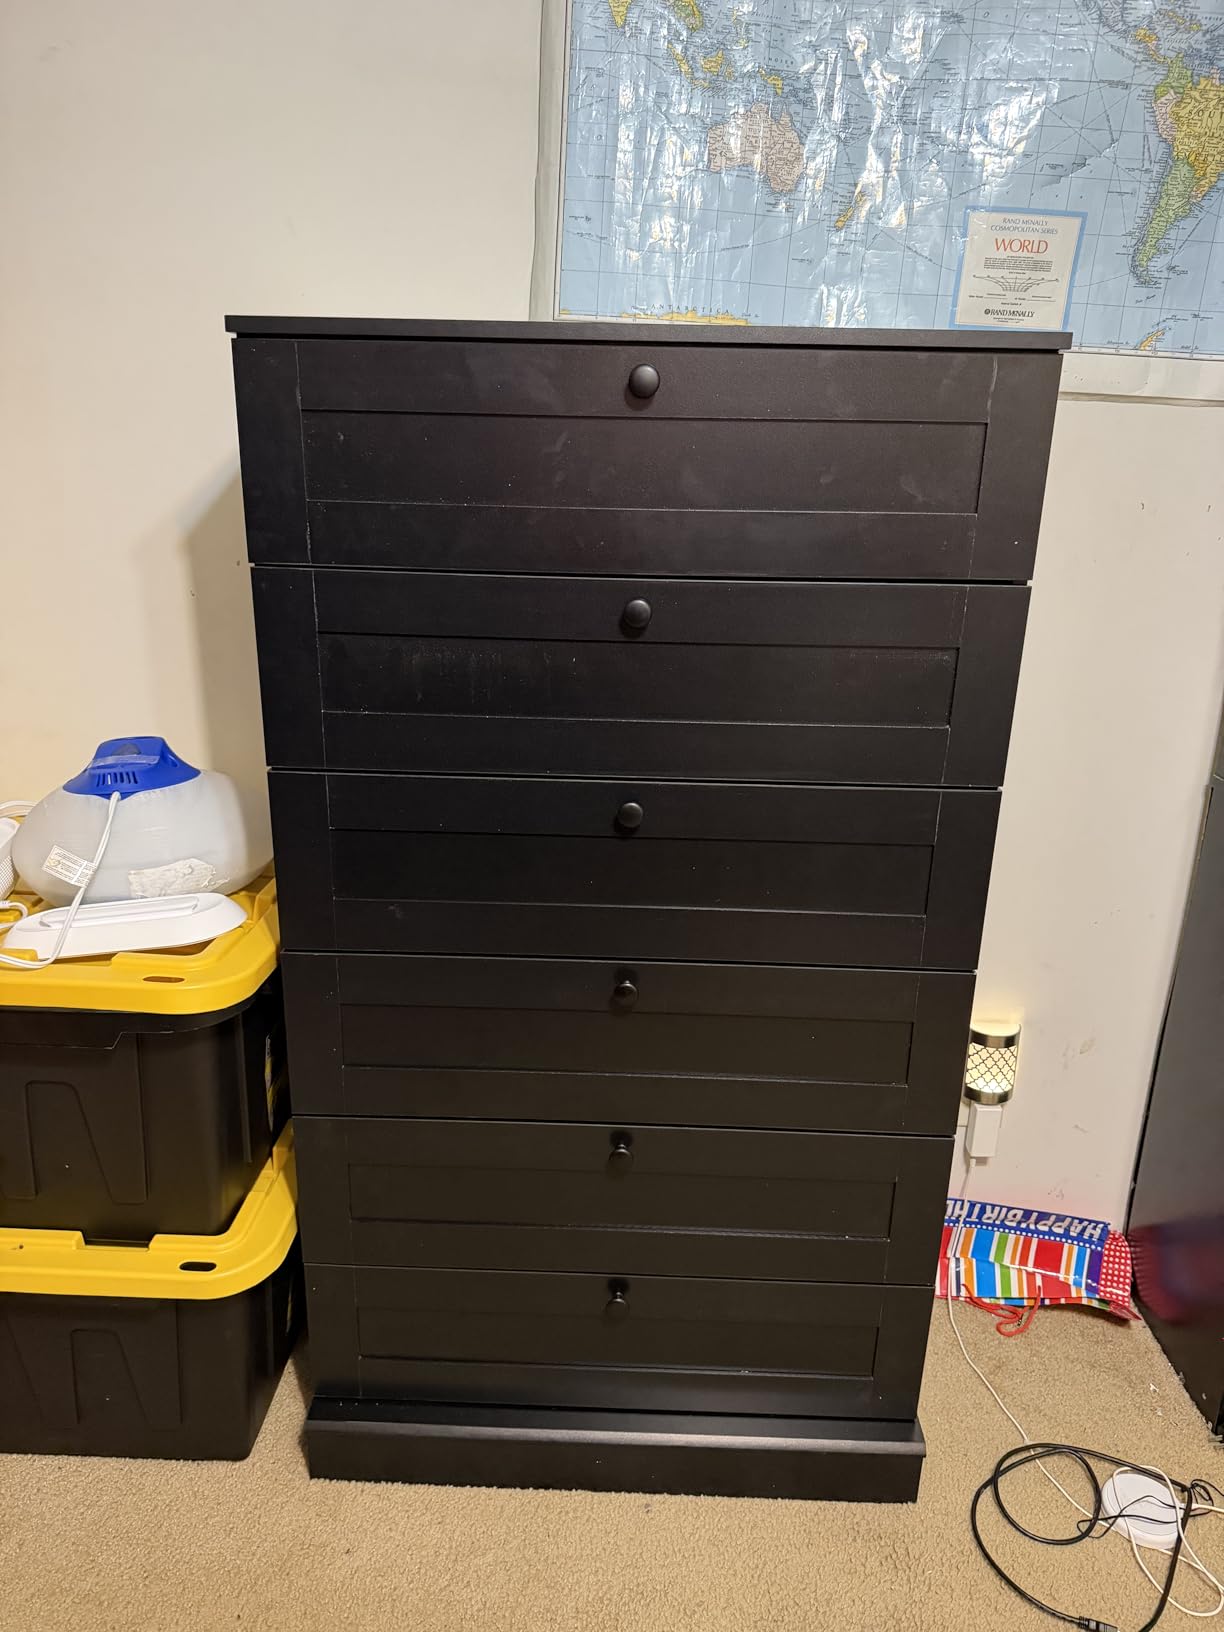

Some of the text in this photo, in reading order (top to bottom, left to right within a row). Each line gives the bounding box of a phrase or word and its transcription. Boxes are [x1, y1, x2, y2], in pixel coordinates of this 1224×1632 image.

[1002, 217, 1020, 225] RAND
[990, 224, 1058, 235] COSMOPOLITAN SERIES
[994, 237, 1049, 254] WORLD
[1021, 1211, 1105, 1241] HAPPY
